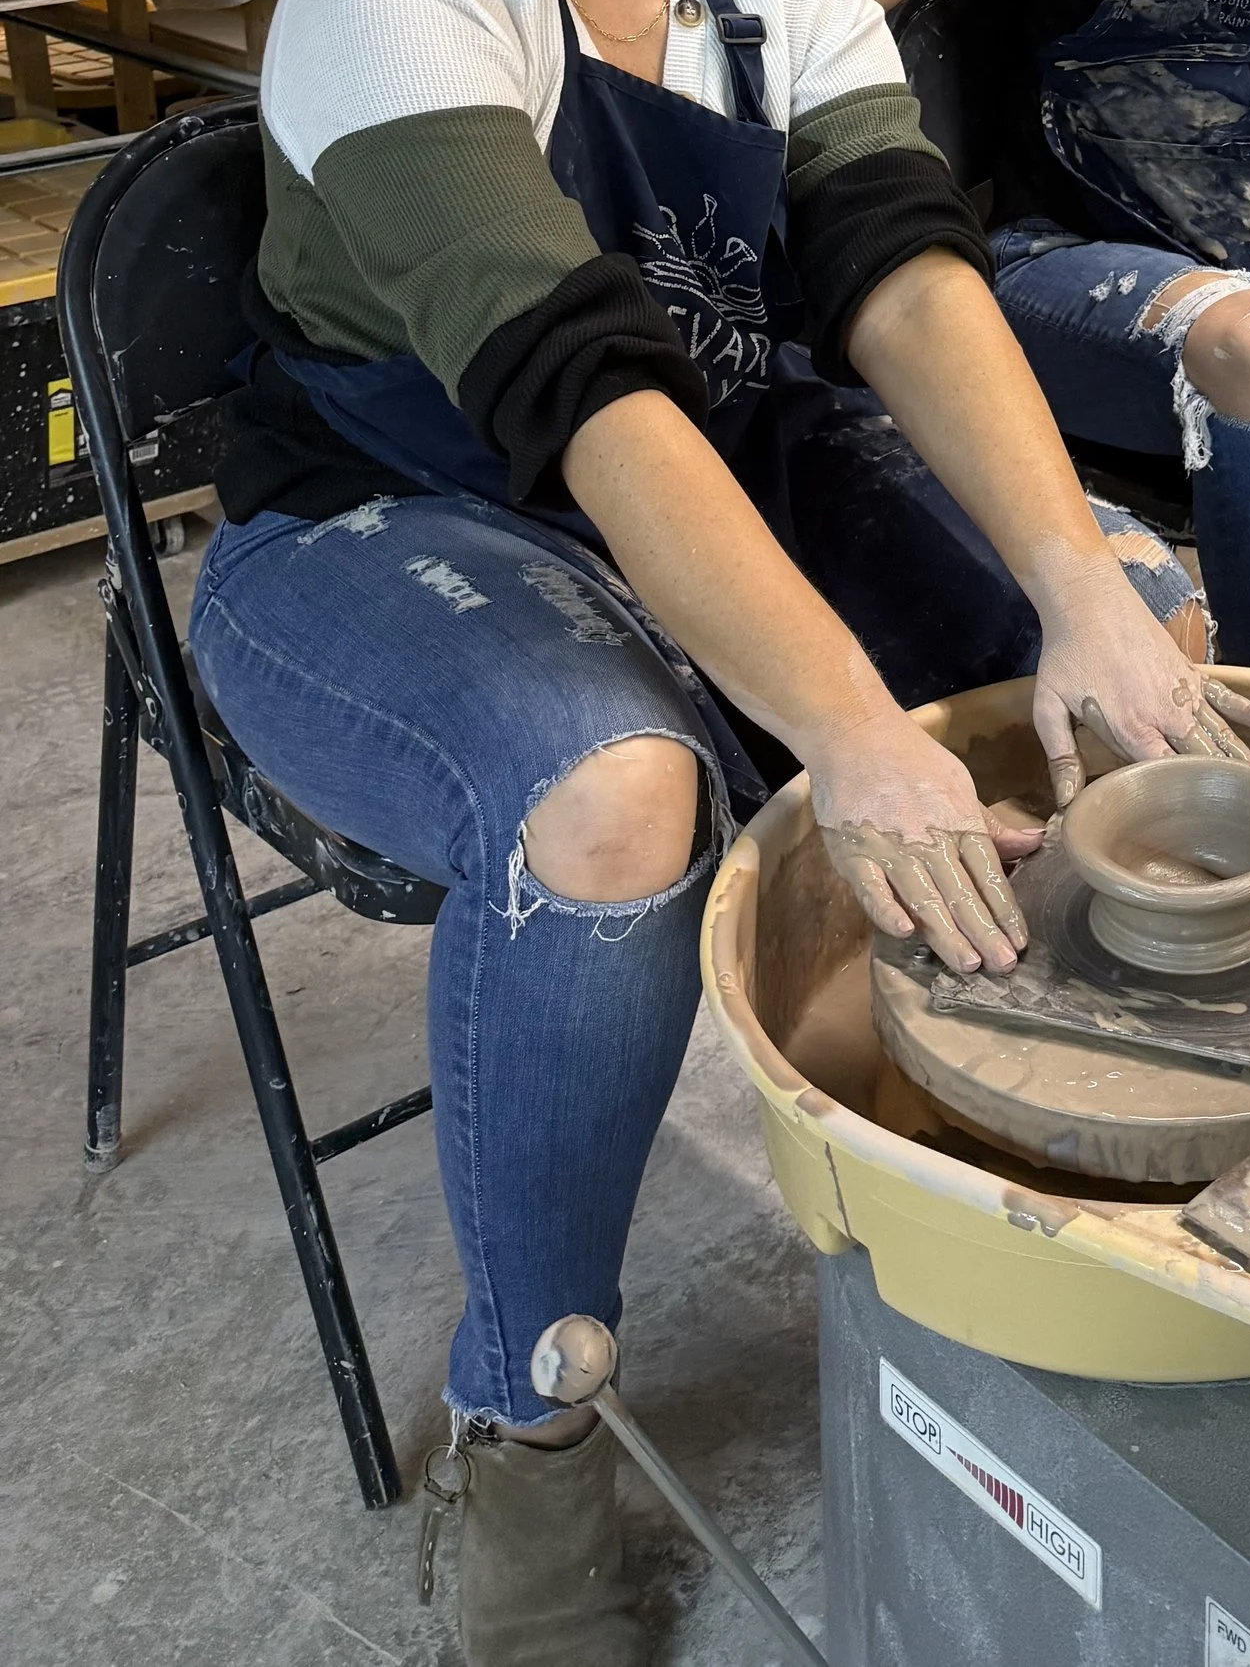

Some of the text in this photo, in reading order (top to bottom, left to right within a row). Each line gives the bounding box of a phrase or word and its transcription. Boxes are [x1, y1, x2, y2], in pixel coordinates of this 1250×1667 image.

[894, 1393, 938, 1443] STOP
[1030, 1511, 1081, 1572] HIGH
[1218, 1619, 1246, 1653] FWD
